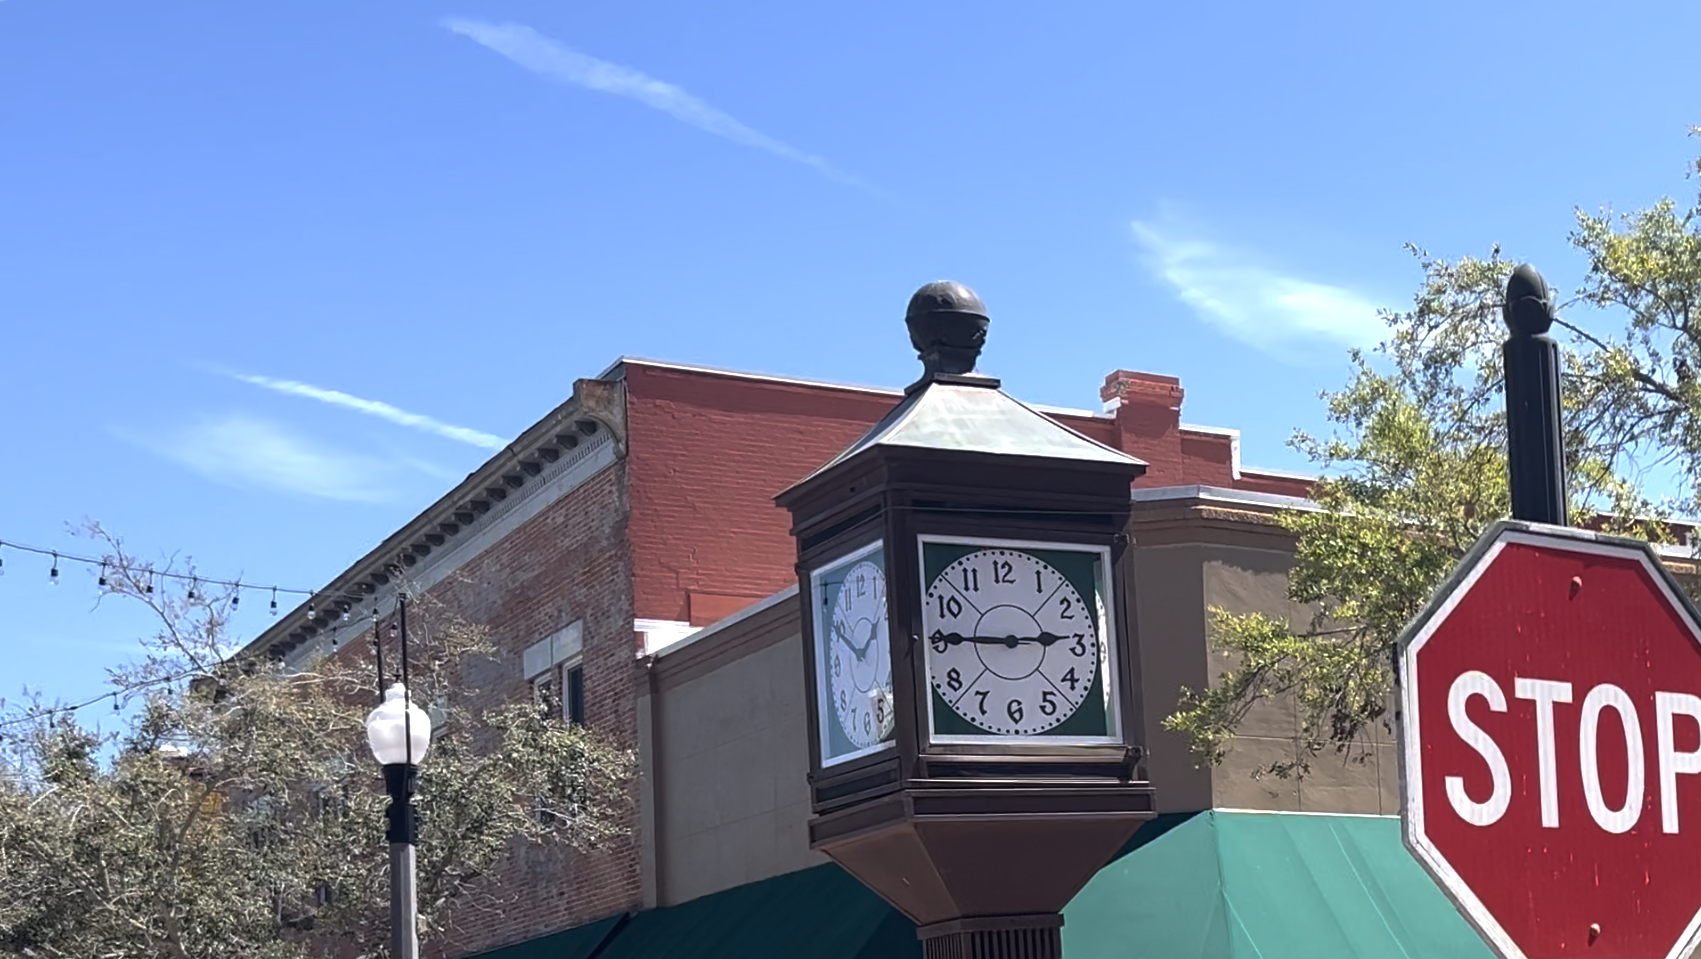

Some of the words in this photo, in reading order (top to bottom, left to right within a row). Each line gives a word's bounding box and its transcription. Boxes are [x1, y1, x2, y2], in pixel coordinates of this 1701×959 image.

[962, 568, 979, 592] 11
[993, 560, 1016, 584] 12
[1035, 569, 1043, 594] 1
[856, 573, 866, 598] 12
[872, 576, 877, 599] 1
[938, 594, 962, 619] 10
[1059, 597, 1075, 619] 2
[1069, 633, 1086, 657] 3
[834, 653, 842, 678] 9
[946, 667, 963, 692] 8
[1060, 666, 1080, 691] 4
[840, 690, 847, 712] 8
[876, 699, 884, 723] 5
[974, 690, 990, 715] 7
[1007, 699, 1024, 724] 6
[1039, 690, 1057, 715] 5
[851, 707, 858, 732] 7
[863, 711, 871, 736] 6
